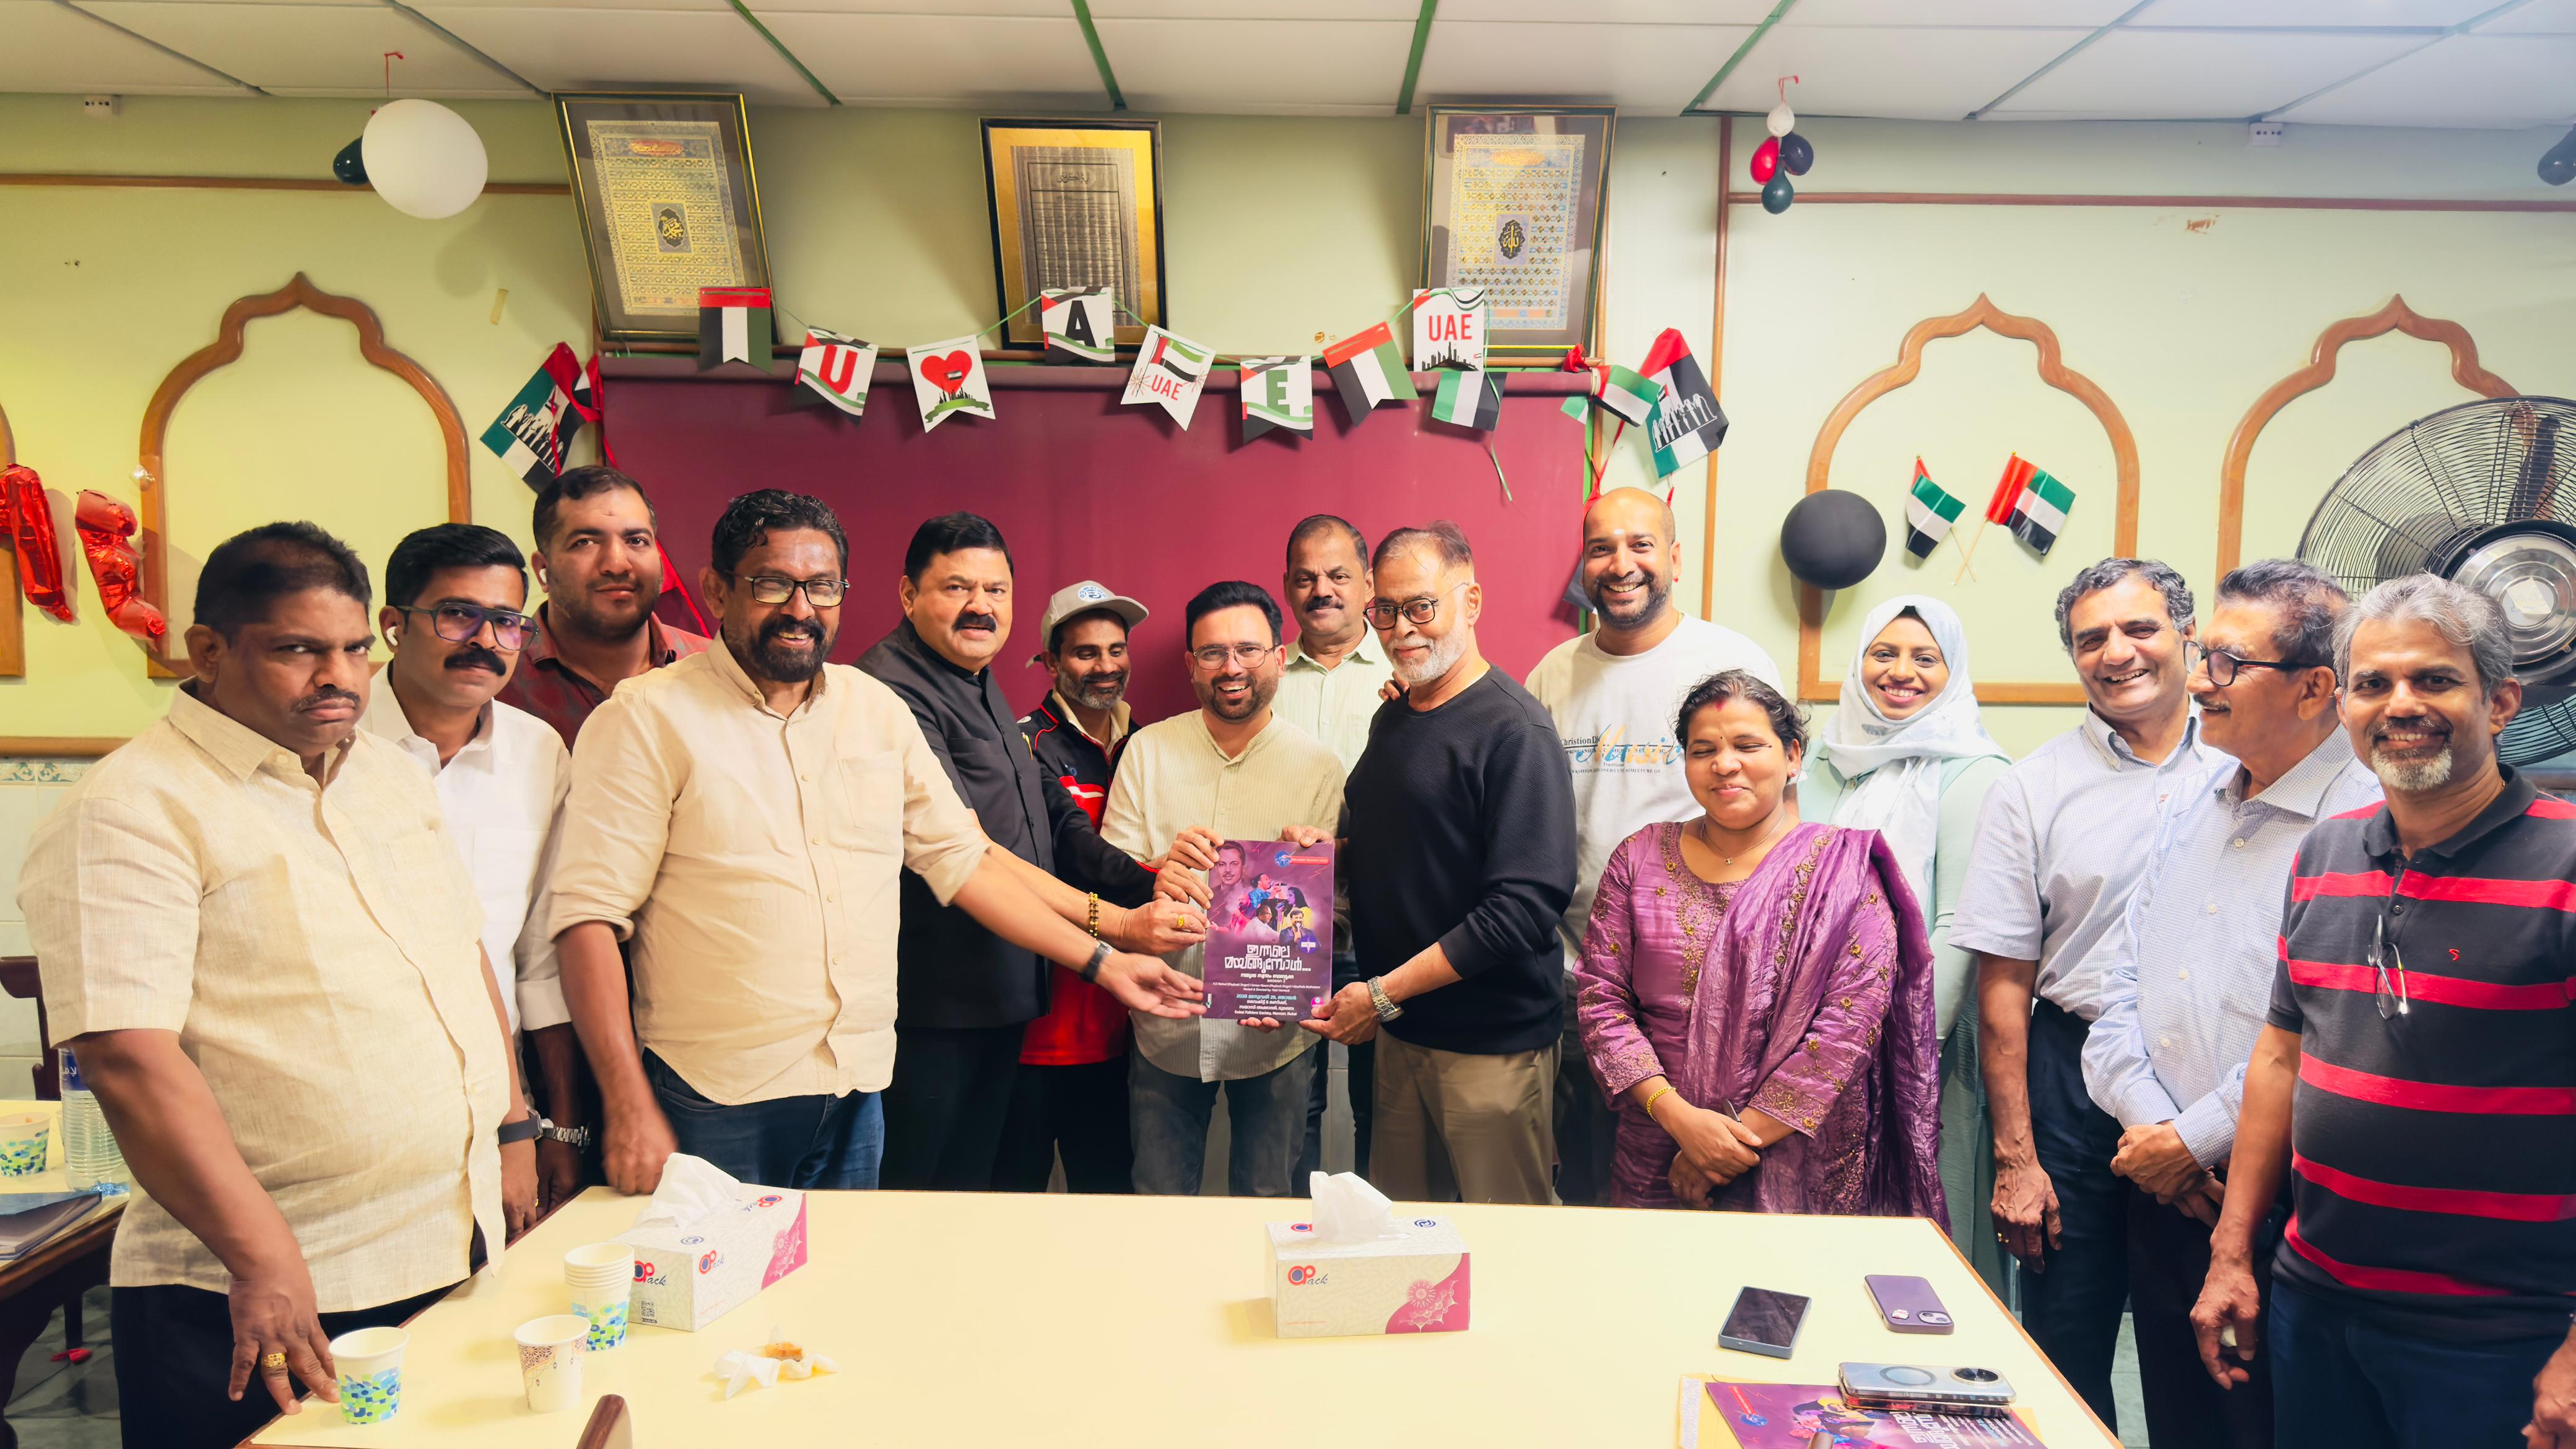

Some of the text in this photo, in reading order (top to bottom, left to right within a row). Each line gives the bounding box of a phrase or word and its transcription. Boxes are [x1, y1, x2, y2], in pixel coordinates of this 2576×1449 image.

[1065, 300, 1097, 348] A
[1429, 314, 1473, 342] UAE
[819, 344, 859, 395] U
[1151, 376, 1183, 401] UAE
[1266, 370, 1290, 416] E
[1245, 944, 1290, 959] ഇന്നലെ
